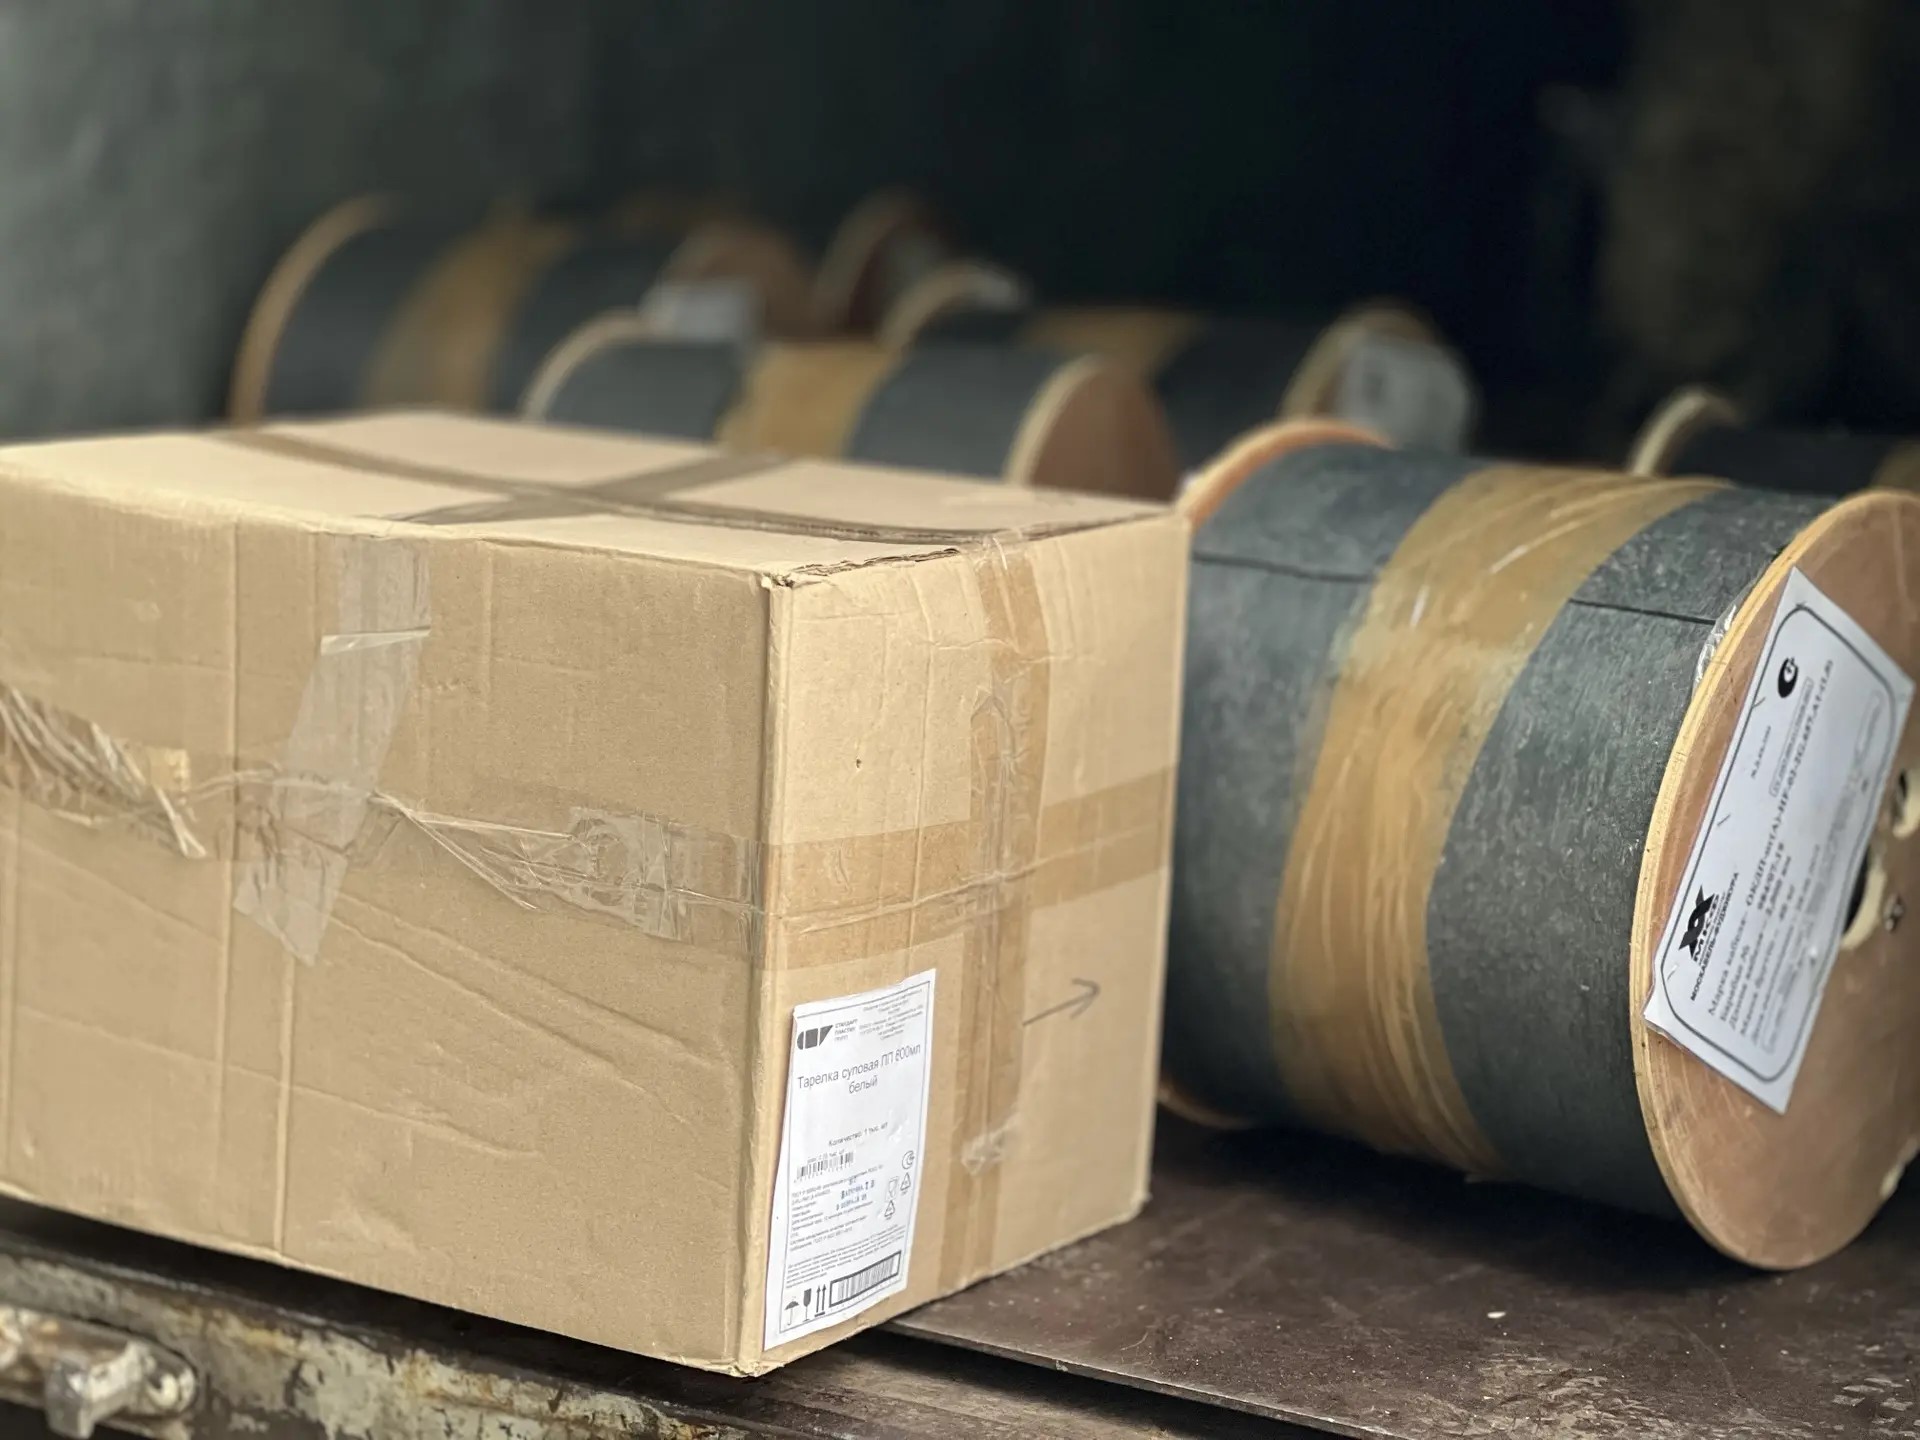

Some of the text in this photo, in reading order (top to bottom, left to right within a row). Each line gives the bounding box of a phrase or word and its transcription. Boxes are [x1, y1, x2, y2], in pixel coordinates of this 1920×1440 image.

[797, 1071, 839, 1090] Тарелка
[841, 1059, 879, 1080] суповая
[880, 1051, 894, 1067] ПП
[848, 1074, 878, 1094] белый
